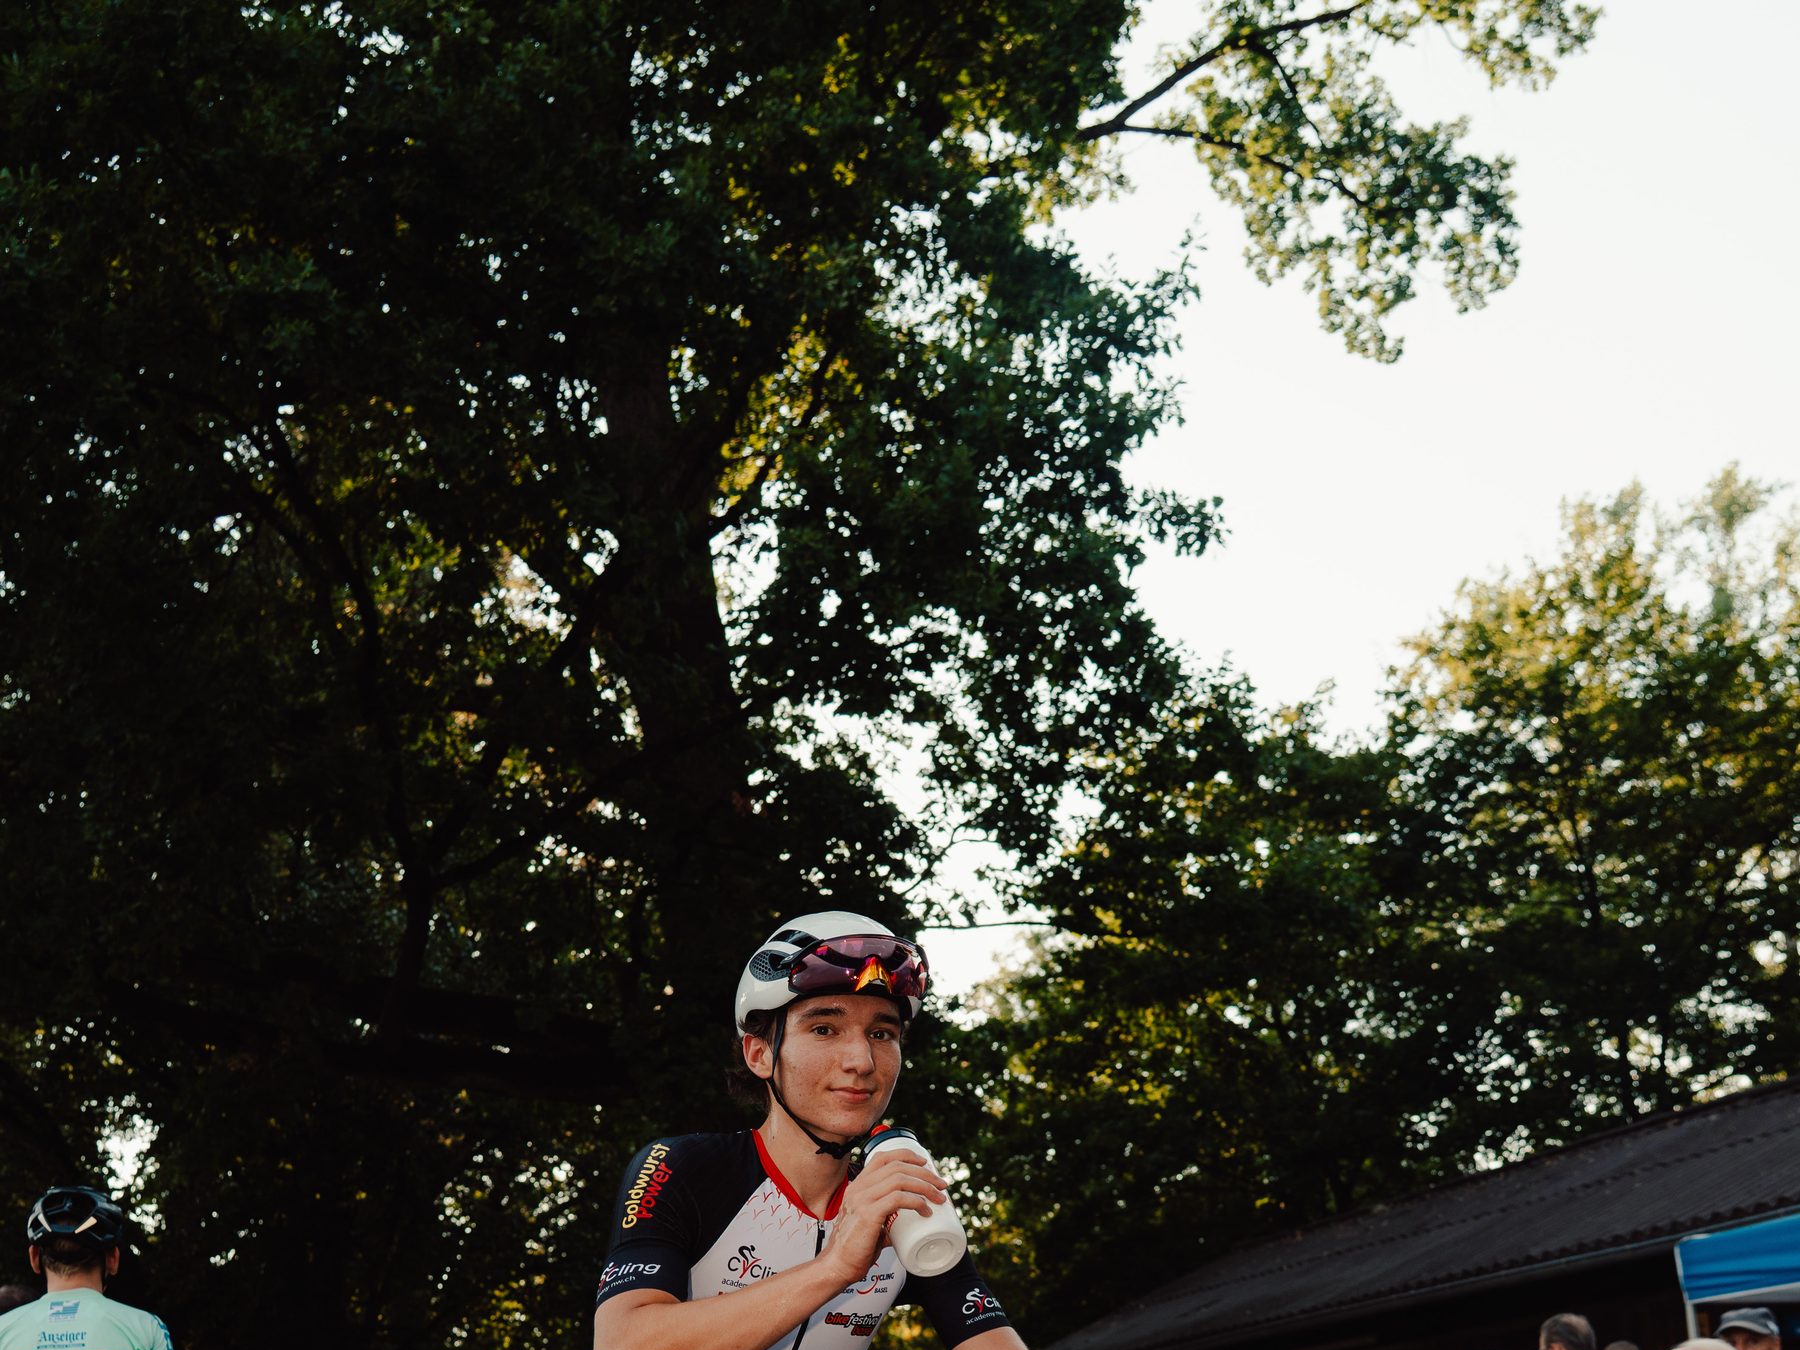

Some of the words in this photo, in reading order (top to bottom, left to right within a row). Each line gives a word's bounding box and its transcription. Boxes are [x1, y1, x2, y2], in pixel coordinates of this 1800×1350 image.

[622, 1143, 670, 1228] Goldwurst
[635, 1162, 672, 1218] Power
[38, 1330, 87, 1344] Anzeiger
